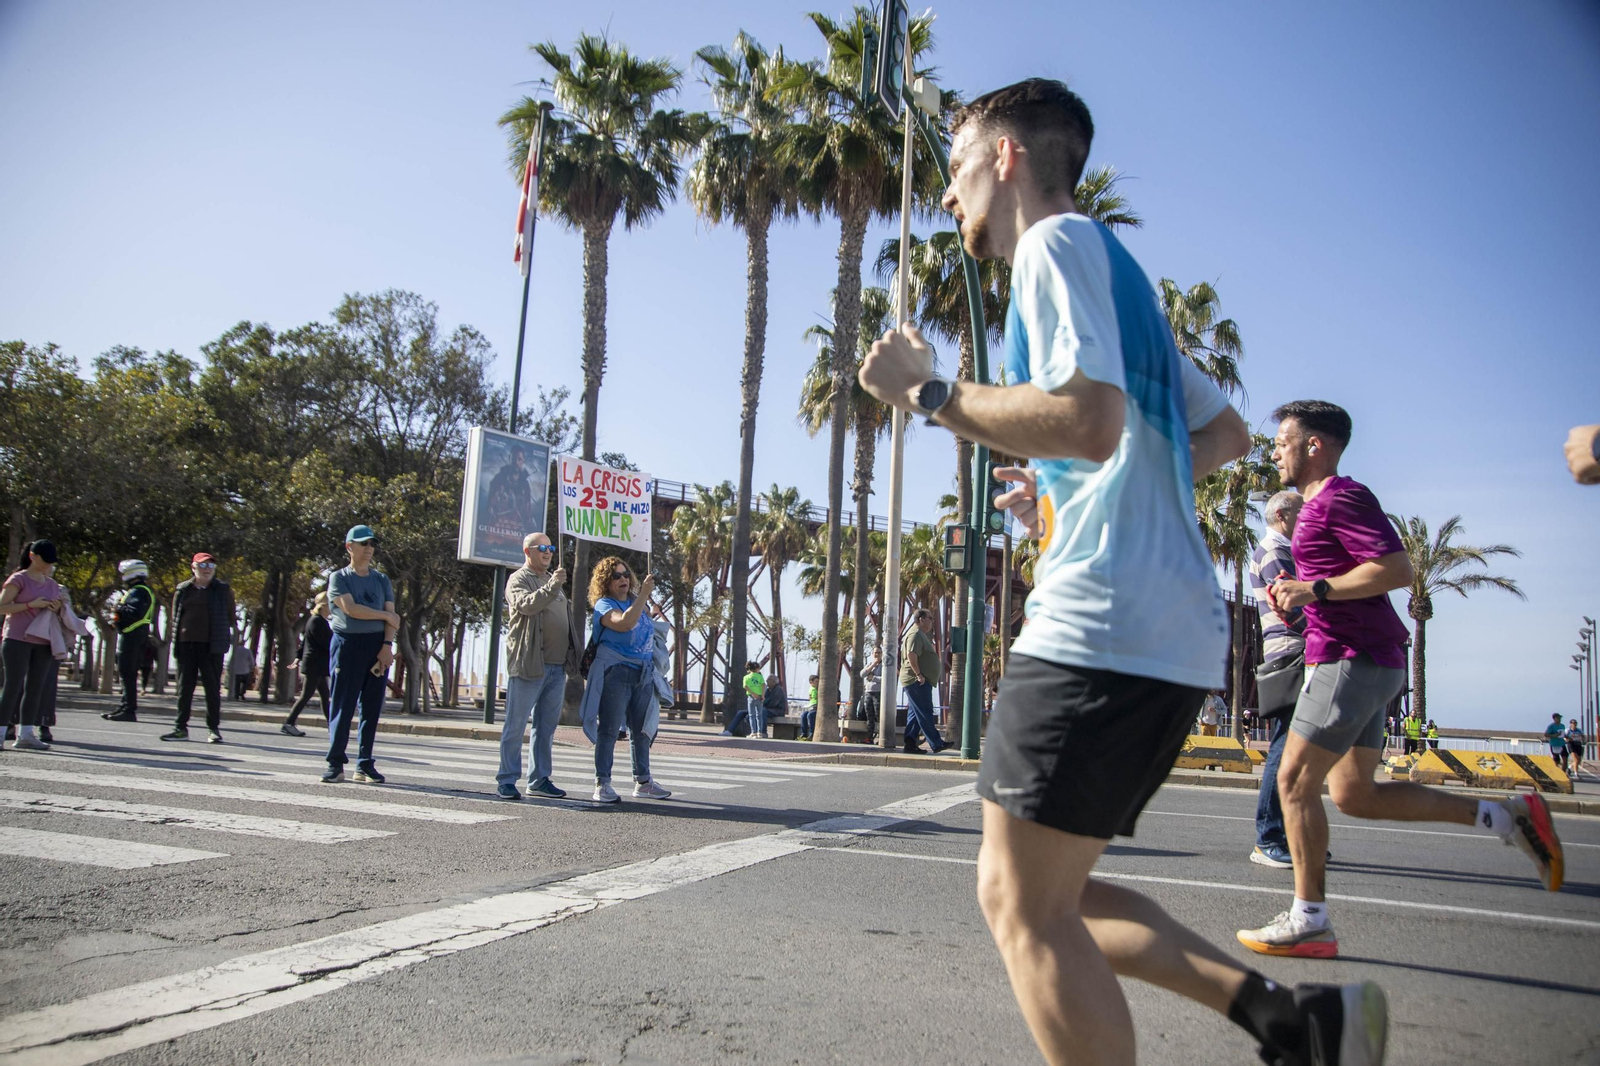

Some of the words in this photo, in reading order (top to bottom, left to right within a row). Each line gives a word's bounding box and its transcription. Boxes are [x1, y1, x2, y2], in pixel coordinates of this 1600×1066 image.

[563, 462, 584, 485] LA
[591, 468, 642, 498] CRISIS
[563, 485, 577, 498] LOS
[580, 487, 608, 509] 25
[613, 501, 628, 513] ME
[630, 502, 650, 514] HIZO
[478, 524, 522, 537] GUILLERMO
[565, 505, 633, 542] RUNNER
